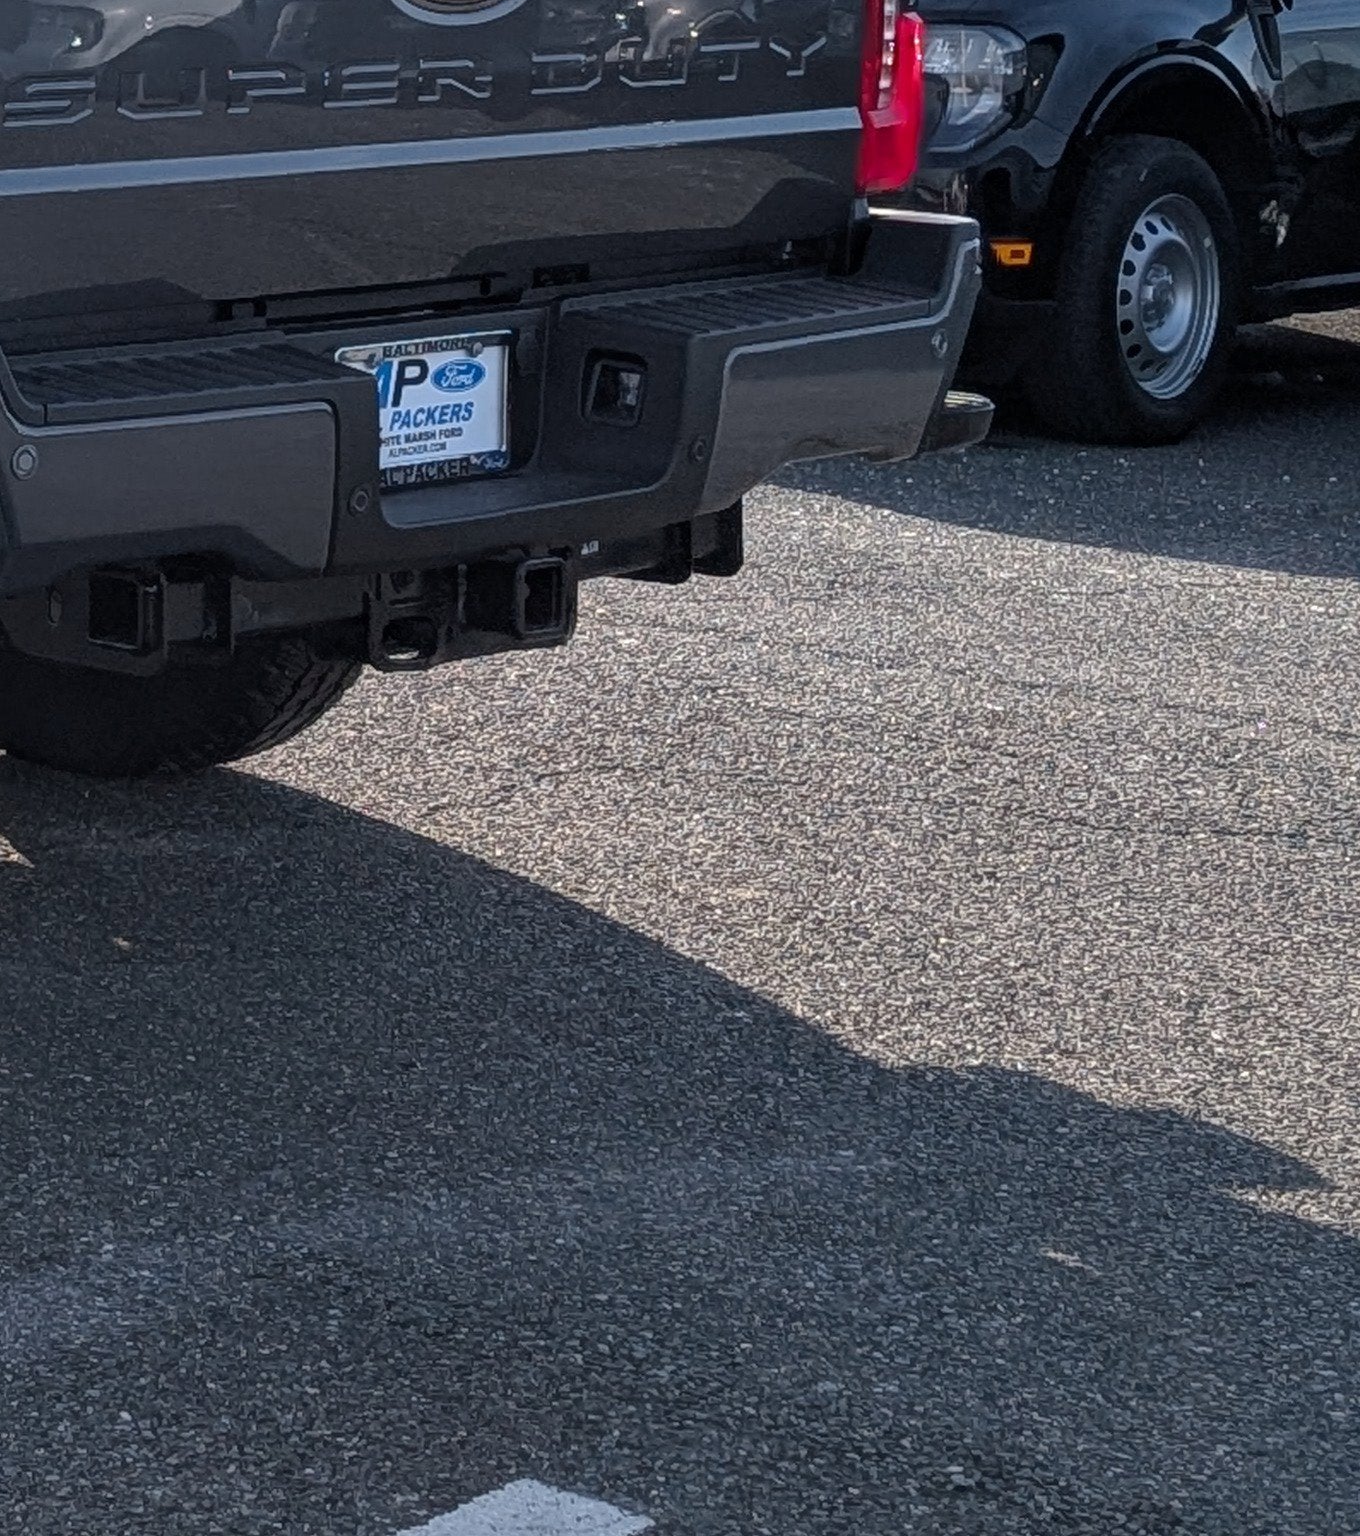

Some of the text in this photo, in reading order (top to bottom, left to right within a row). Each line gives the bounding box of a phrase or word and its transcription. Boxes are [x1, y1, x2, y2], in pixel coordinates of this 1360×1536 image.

[3, 36, 828, 128] SUPER DUTY
[389, 401, 475, 432] PACKERS
[404, 429, 437, 444] MARSH
[439, 426, 464, 440] FORD
[402, 458, 470, 484] PACKER
